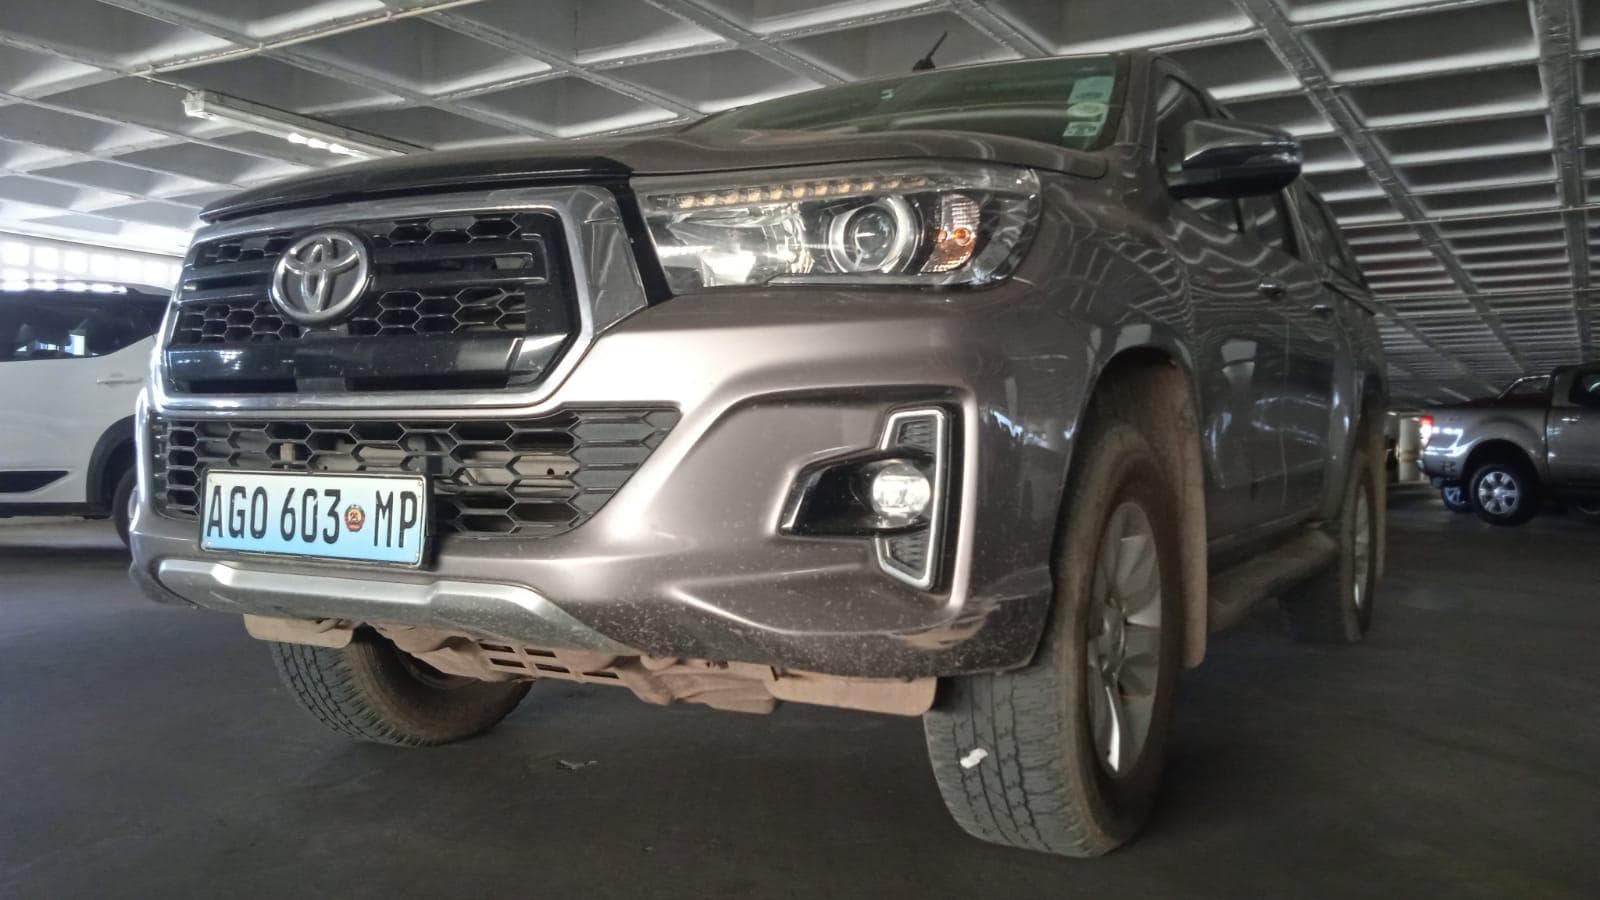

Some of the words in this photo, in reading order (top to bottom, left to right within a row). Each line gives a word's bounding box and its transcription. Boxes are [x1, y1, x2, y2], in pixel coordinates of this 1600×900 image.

[207, 485, 268, 539] AGO
[280, 487, 341, 544] 603
[374, 490, 418, 548] MP
